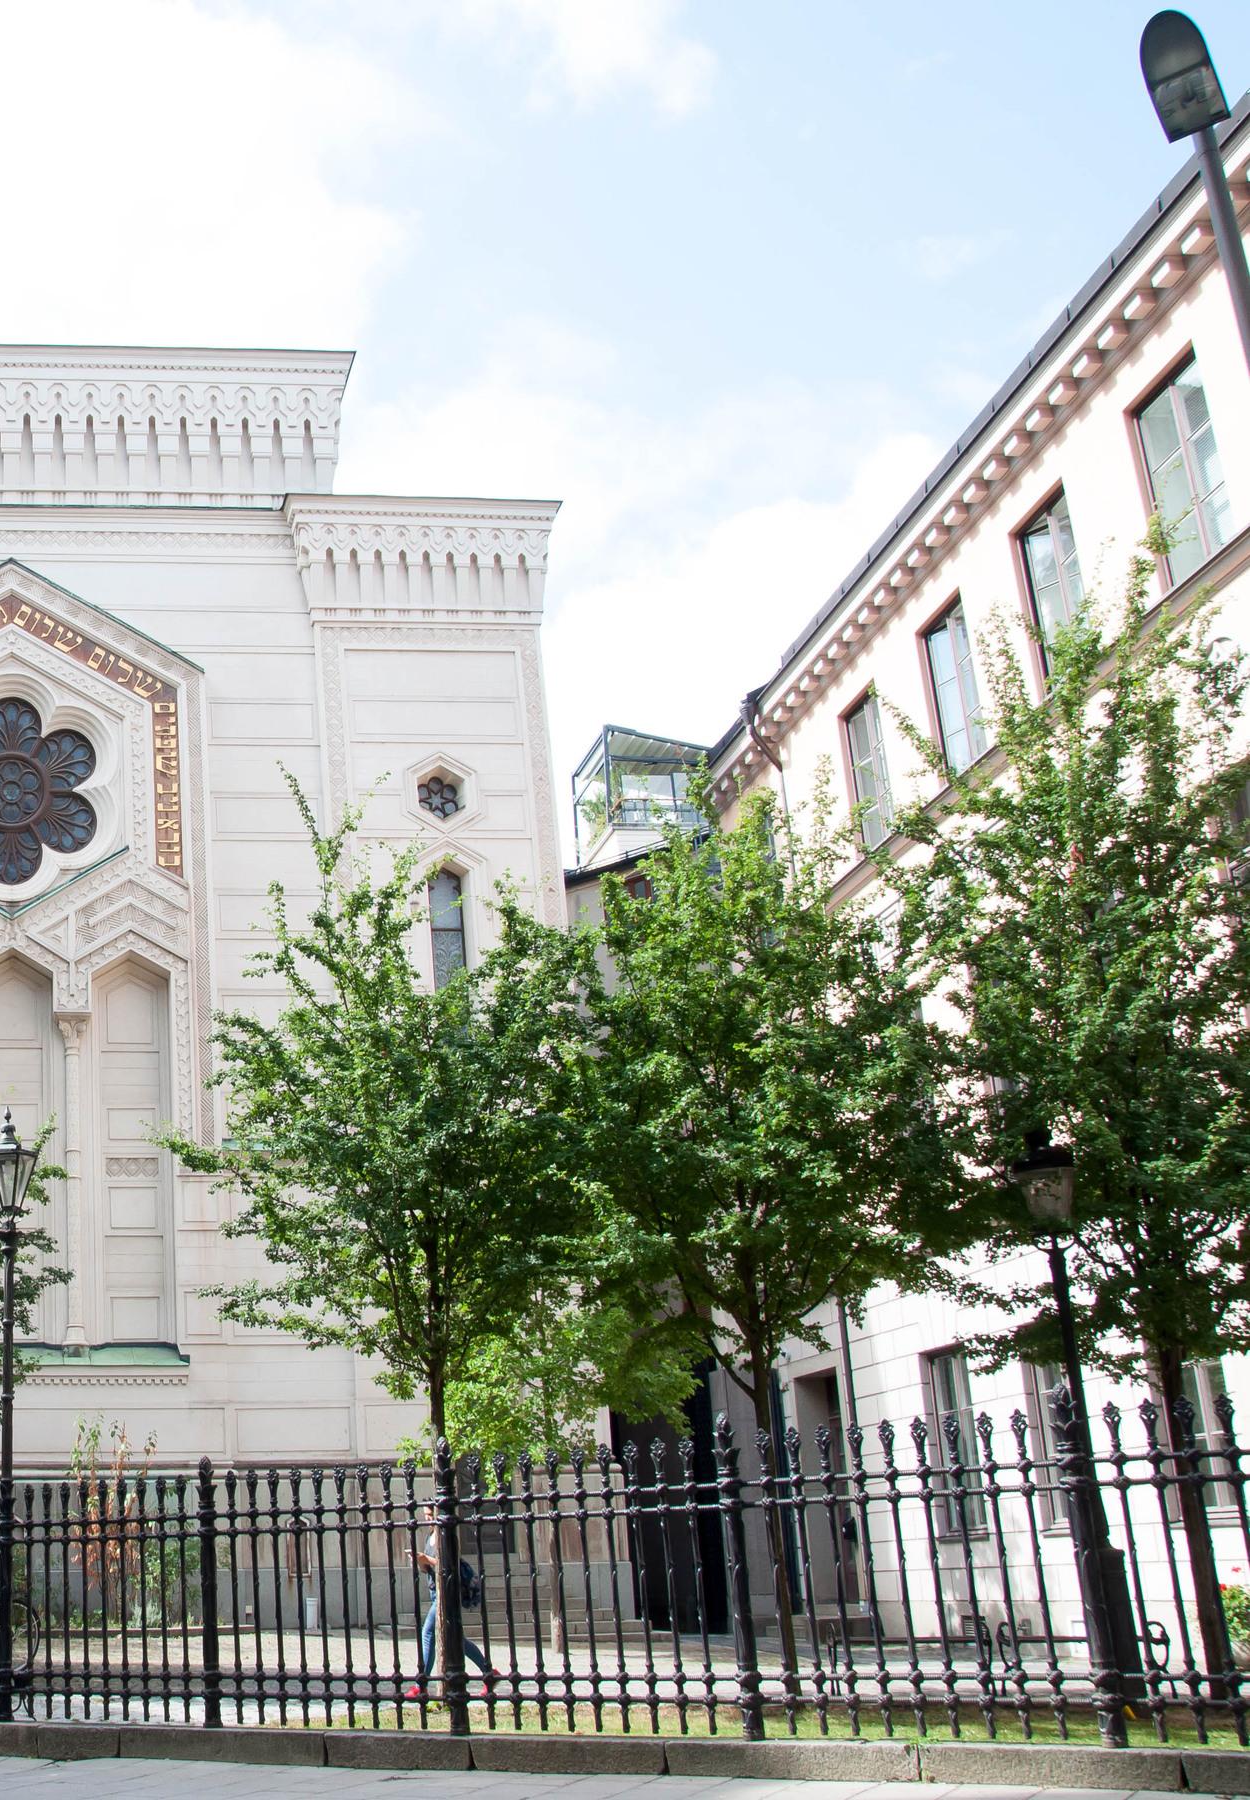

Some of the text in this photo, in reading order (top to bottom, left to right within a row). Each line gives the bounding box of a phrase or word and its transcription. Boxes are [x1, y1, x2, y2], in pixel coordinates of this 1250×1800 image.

[13, 603, 162, 698] שלום שלום
[154, 702, 181, 867] בורא ניב שפתים
